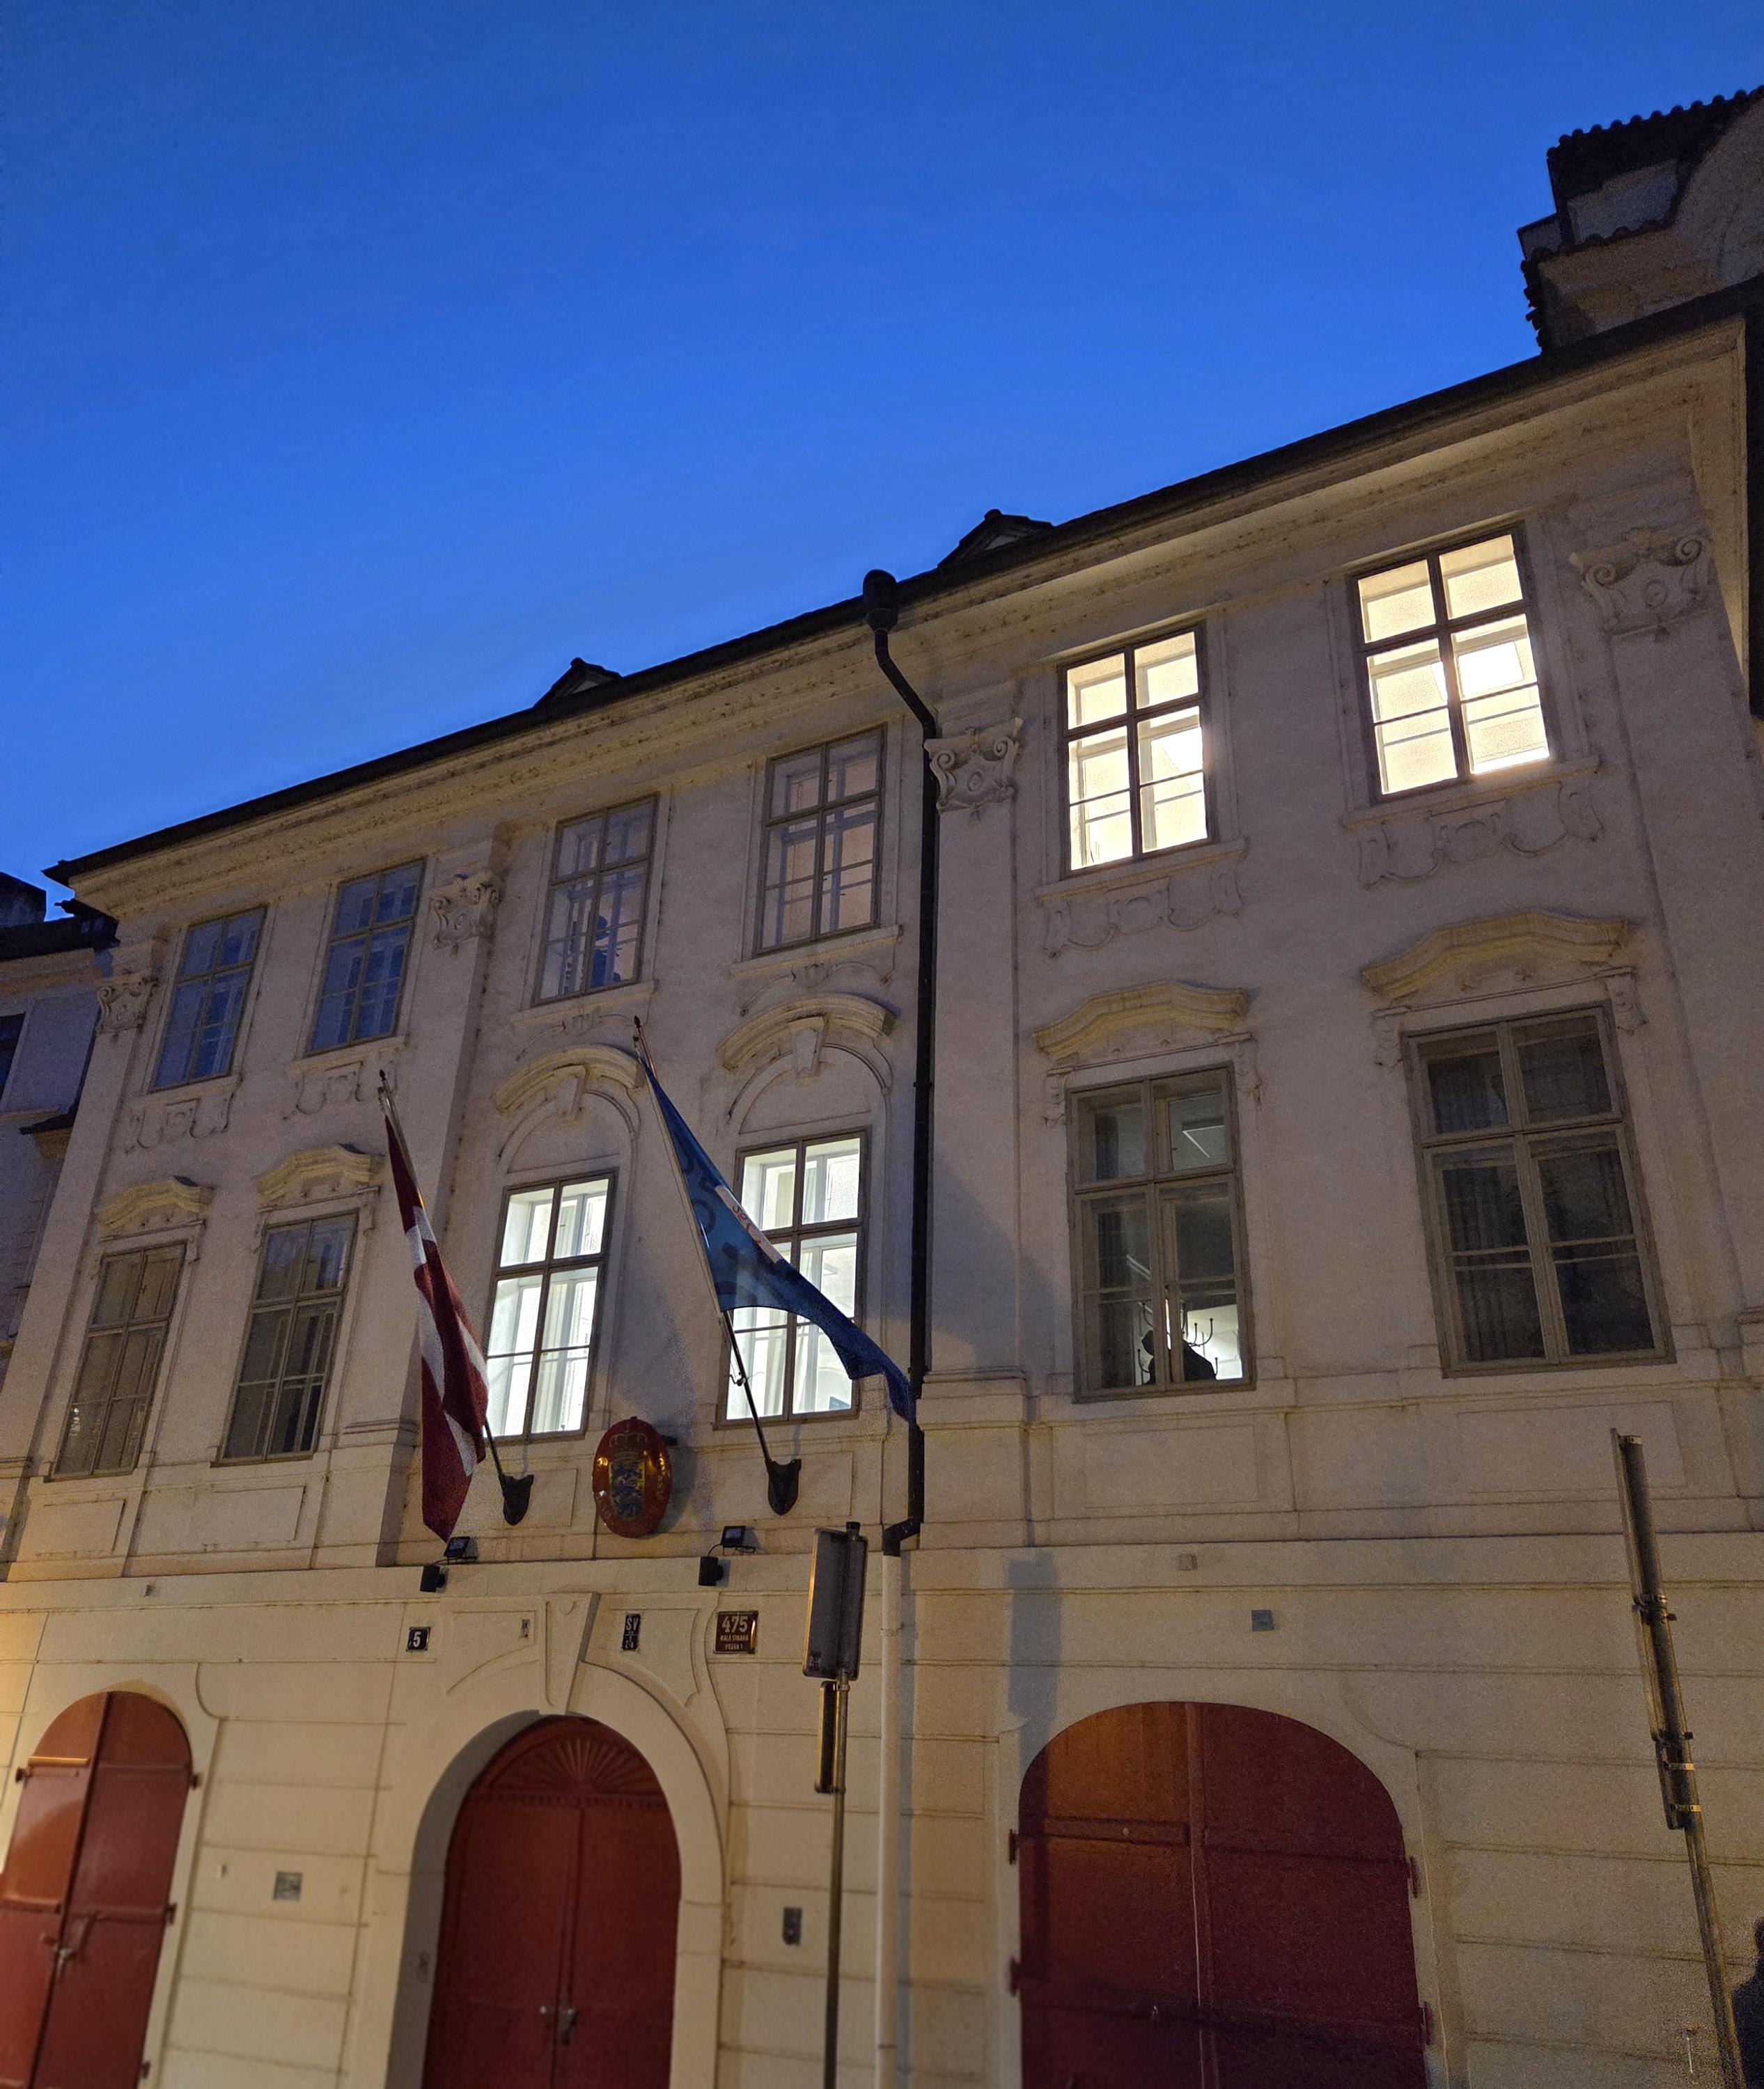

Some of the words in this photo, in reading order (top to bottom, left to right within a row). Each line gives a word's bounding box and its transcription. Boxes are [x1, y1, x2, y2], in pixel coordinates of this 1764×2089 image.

[626, 1618, 639, 1630] SV
[721, 1615, 748, 1633] 475
[413, 1631, 421, 1648] 5
